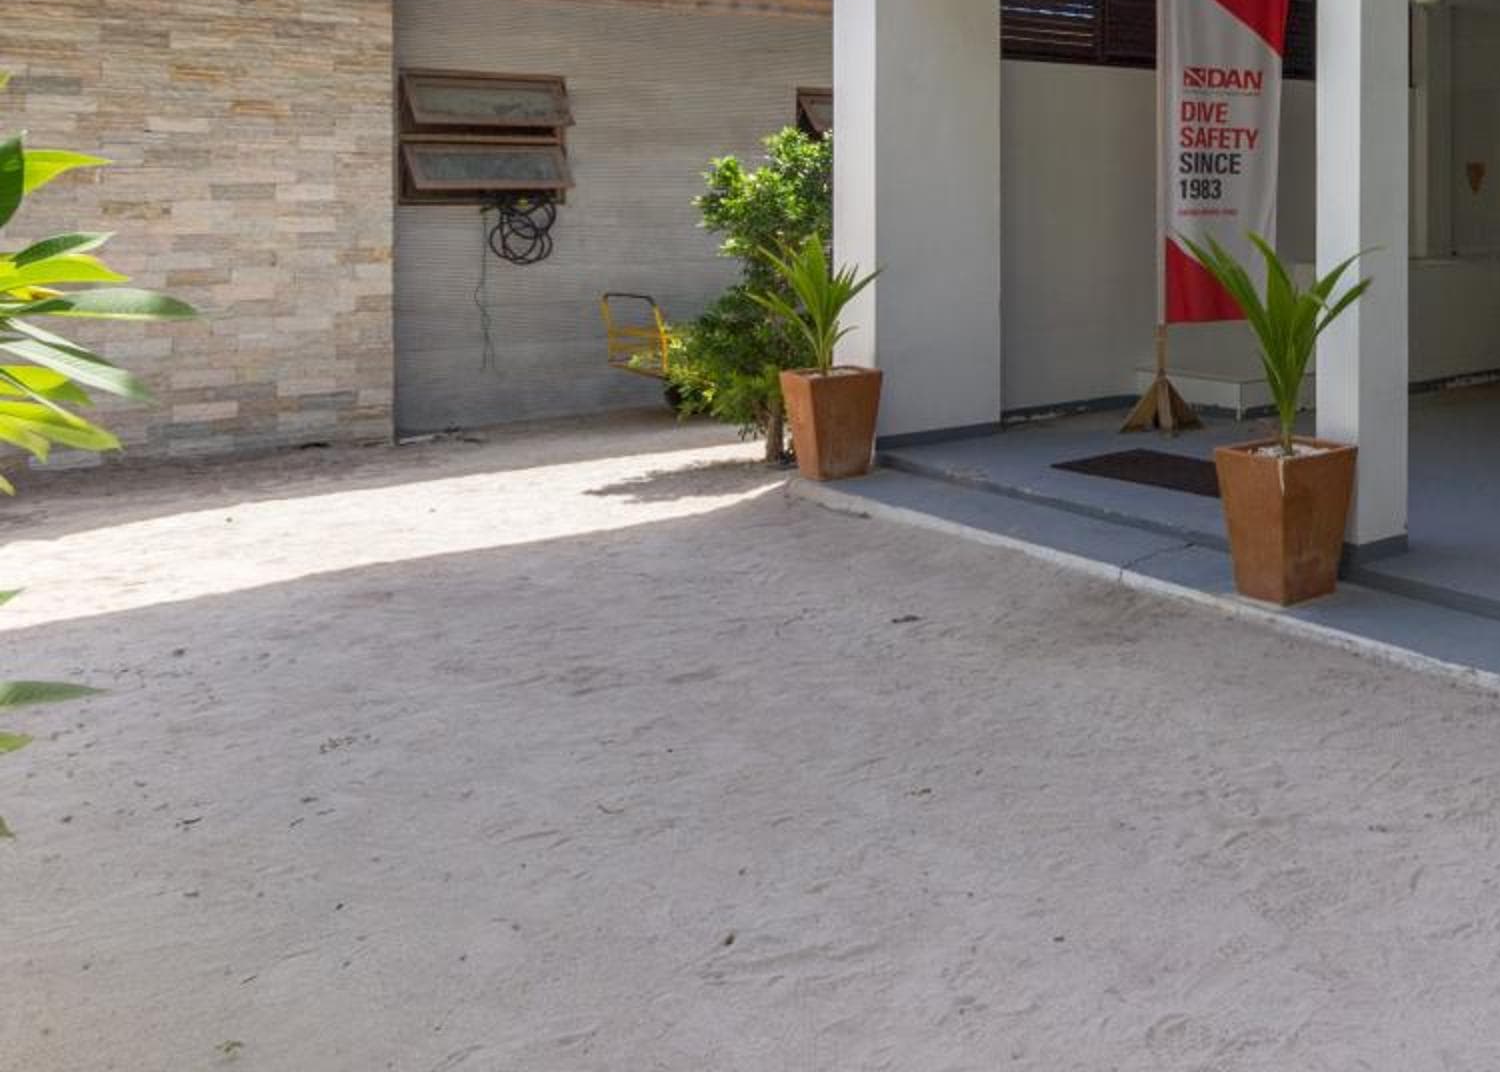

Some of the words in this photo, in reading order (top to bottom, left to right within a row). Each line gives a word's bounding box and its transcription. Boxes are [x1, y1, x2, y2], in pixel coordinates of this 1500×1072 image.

[1207, 68, 1263, 89] DAN
[1180, 101, 1229, 123] DIVE
[1180, 127, 1260, 150] SAFETY
[1179, 153, 1242, 175] SINCE
[1179, 178, 1222, 200] 1983
